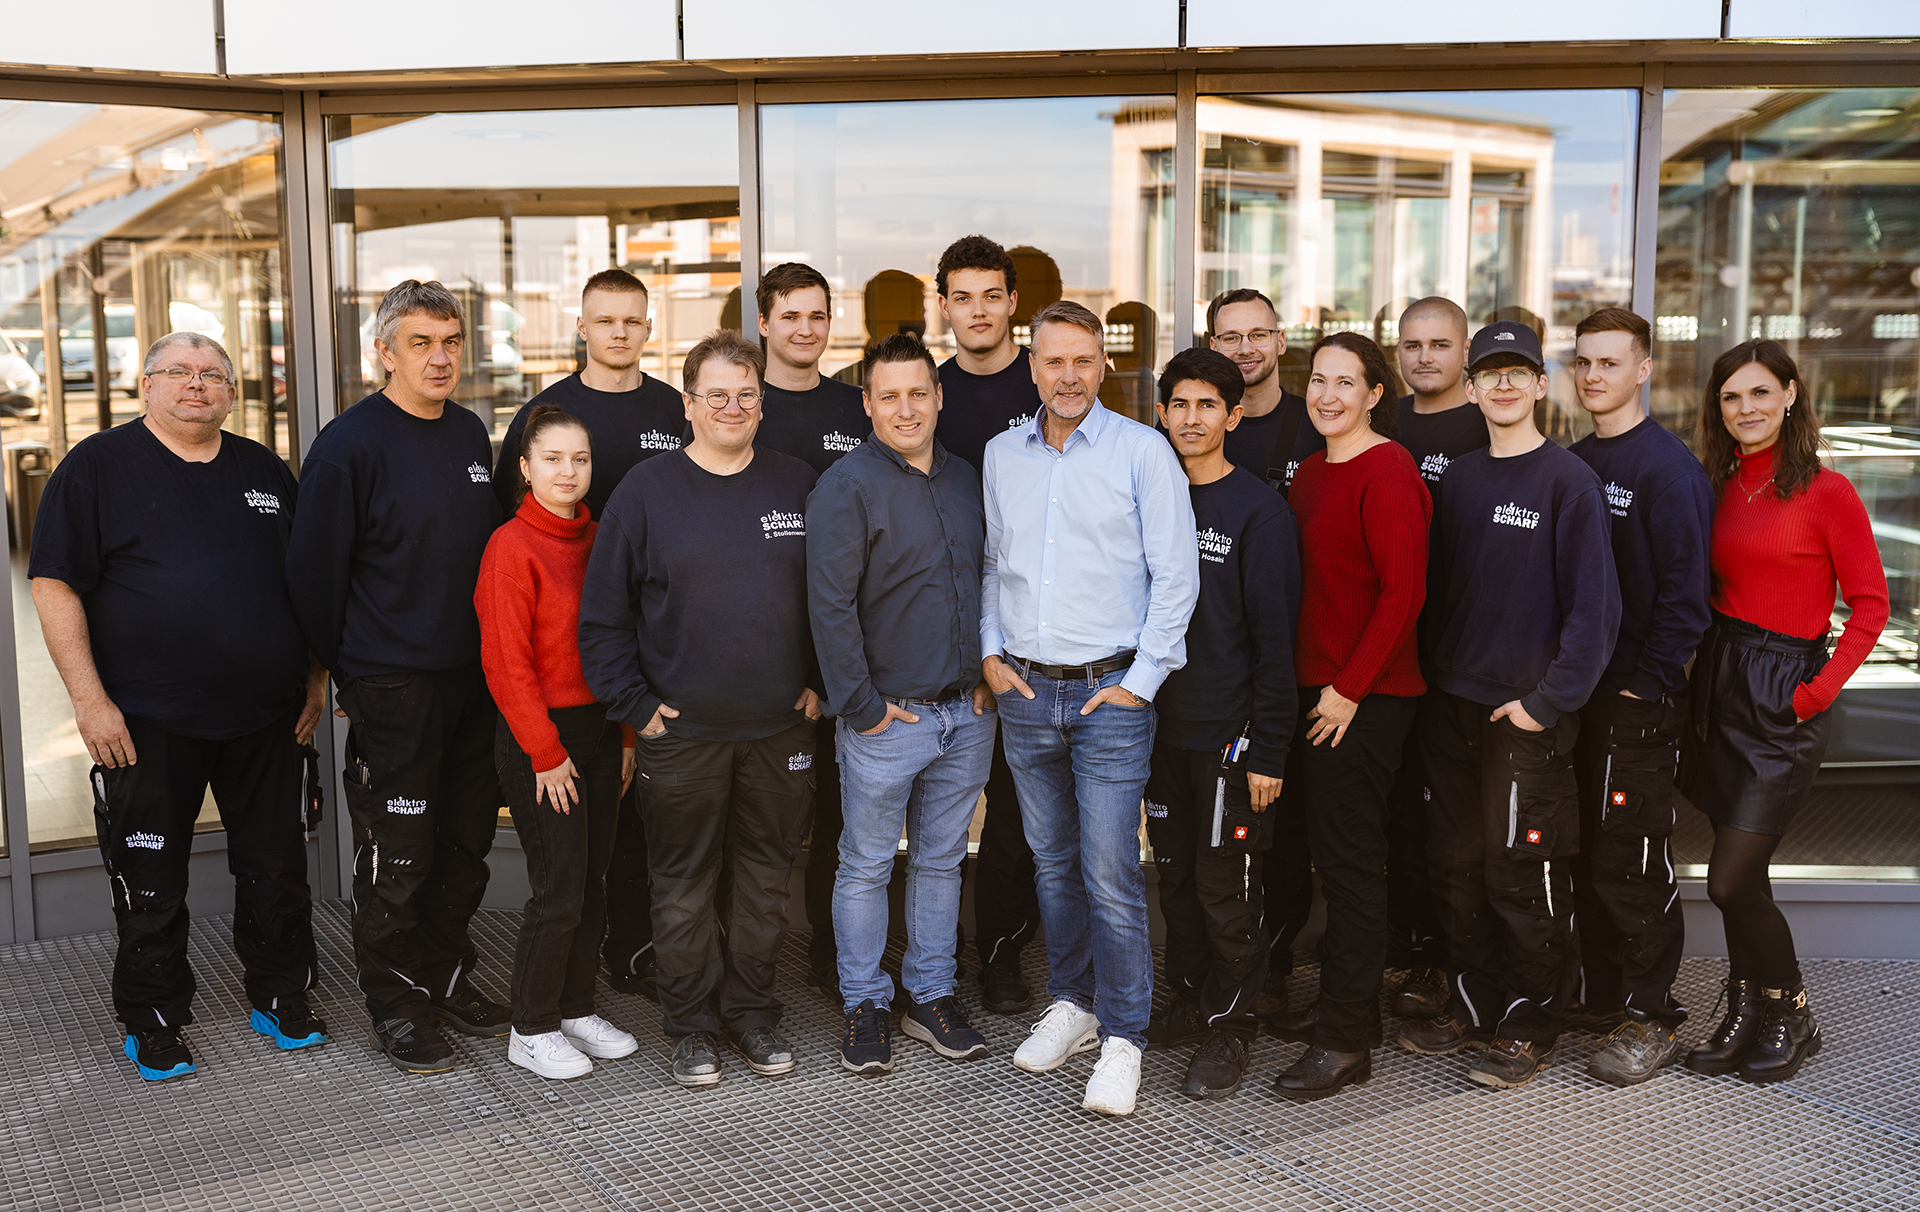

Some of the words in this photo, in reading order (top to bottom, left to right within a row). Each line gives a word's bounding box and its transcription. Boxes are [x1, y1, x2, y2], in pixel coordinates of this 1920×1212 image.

[823, 442, 859, 452] SCHAR
[1607, 494, 1632, 508] HARF
[1492, 513, 1539, 530] SCHARF
[1196, 540, 1232, 556] CHARF
[387, 805, 426, 815] SCHARF
[127, 840, 165, 850] SCHARF
